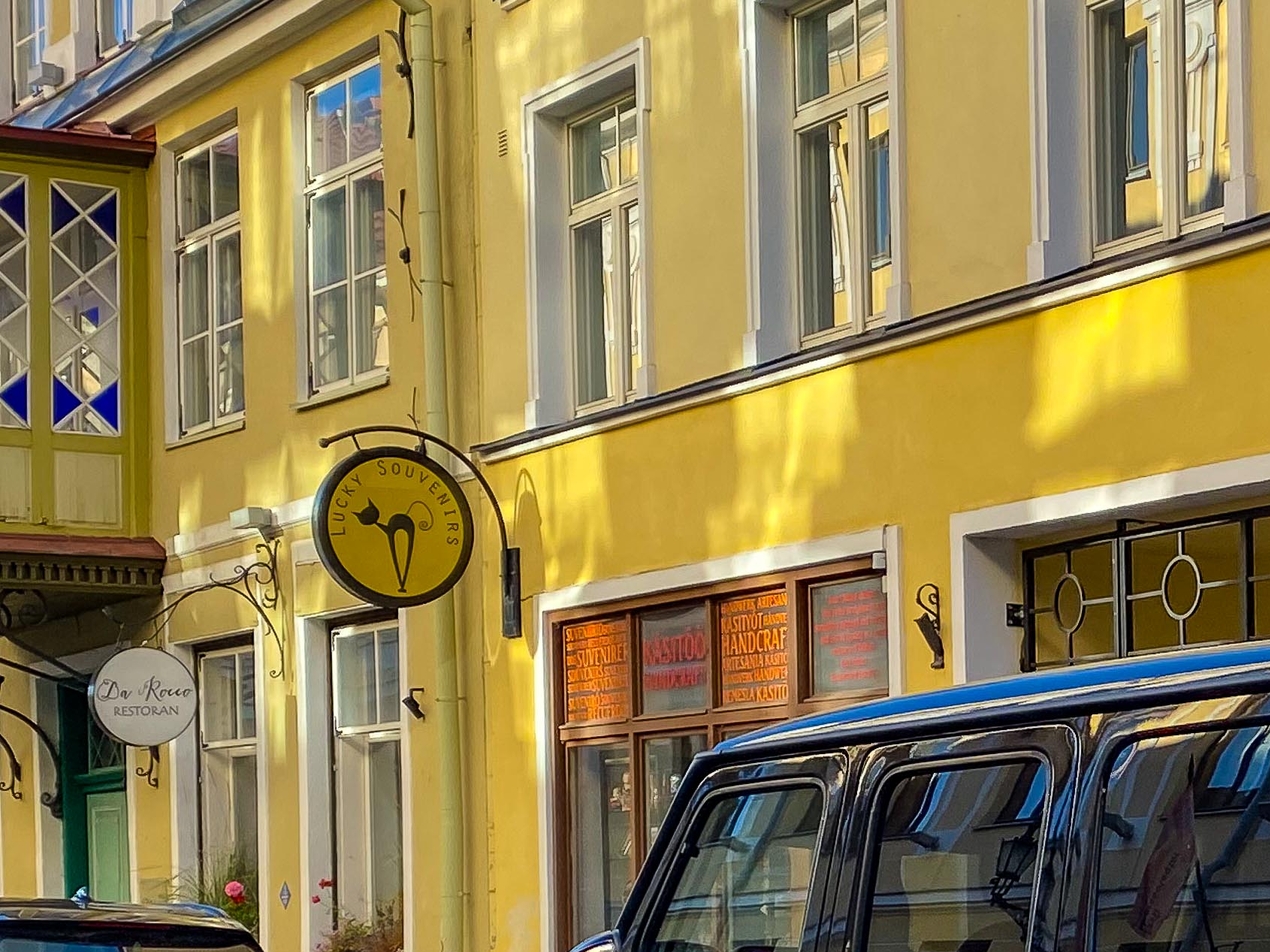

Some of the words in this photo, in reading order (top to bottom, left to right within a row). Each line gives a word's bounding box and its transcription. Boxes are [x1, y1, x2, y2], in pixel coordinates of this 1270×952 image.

[331, 474, 362, 536] LUCKY
[377, 460, 460, 545] SOUVENIRS
[97, 678, 132, 702] Da
[138, 676, 193, 702] Rocco
[114, 705, 179, 717] RESTORAN
